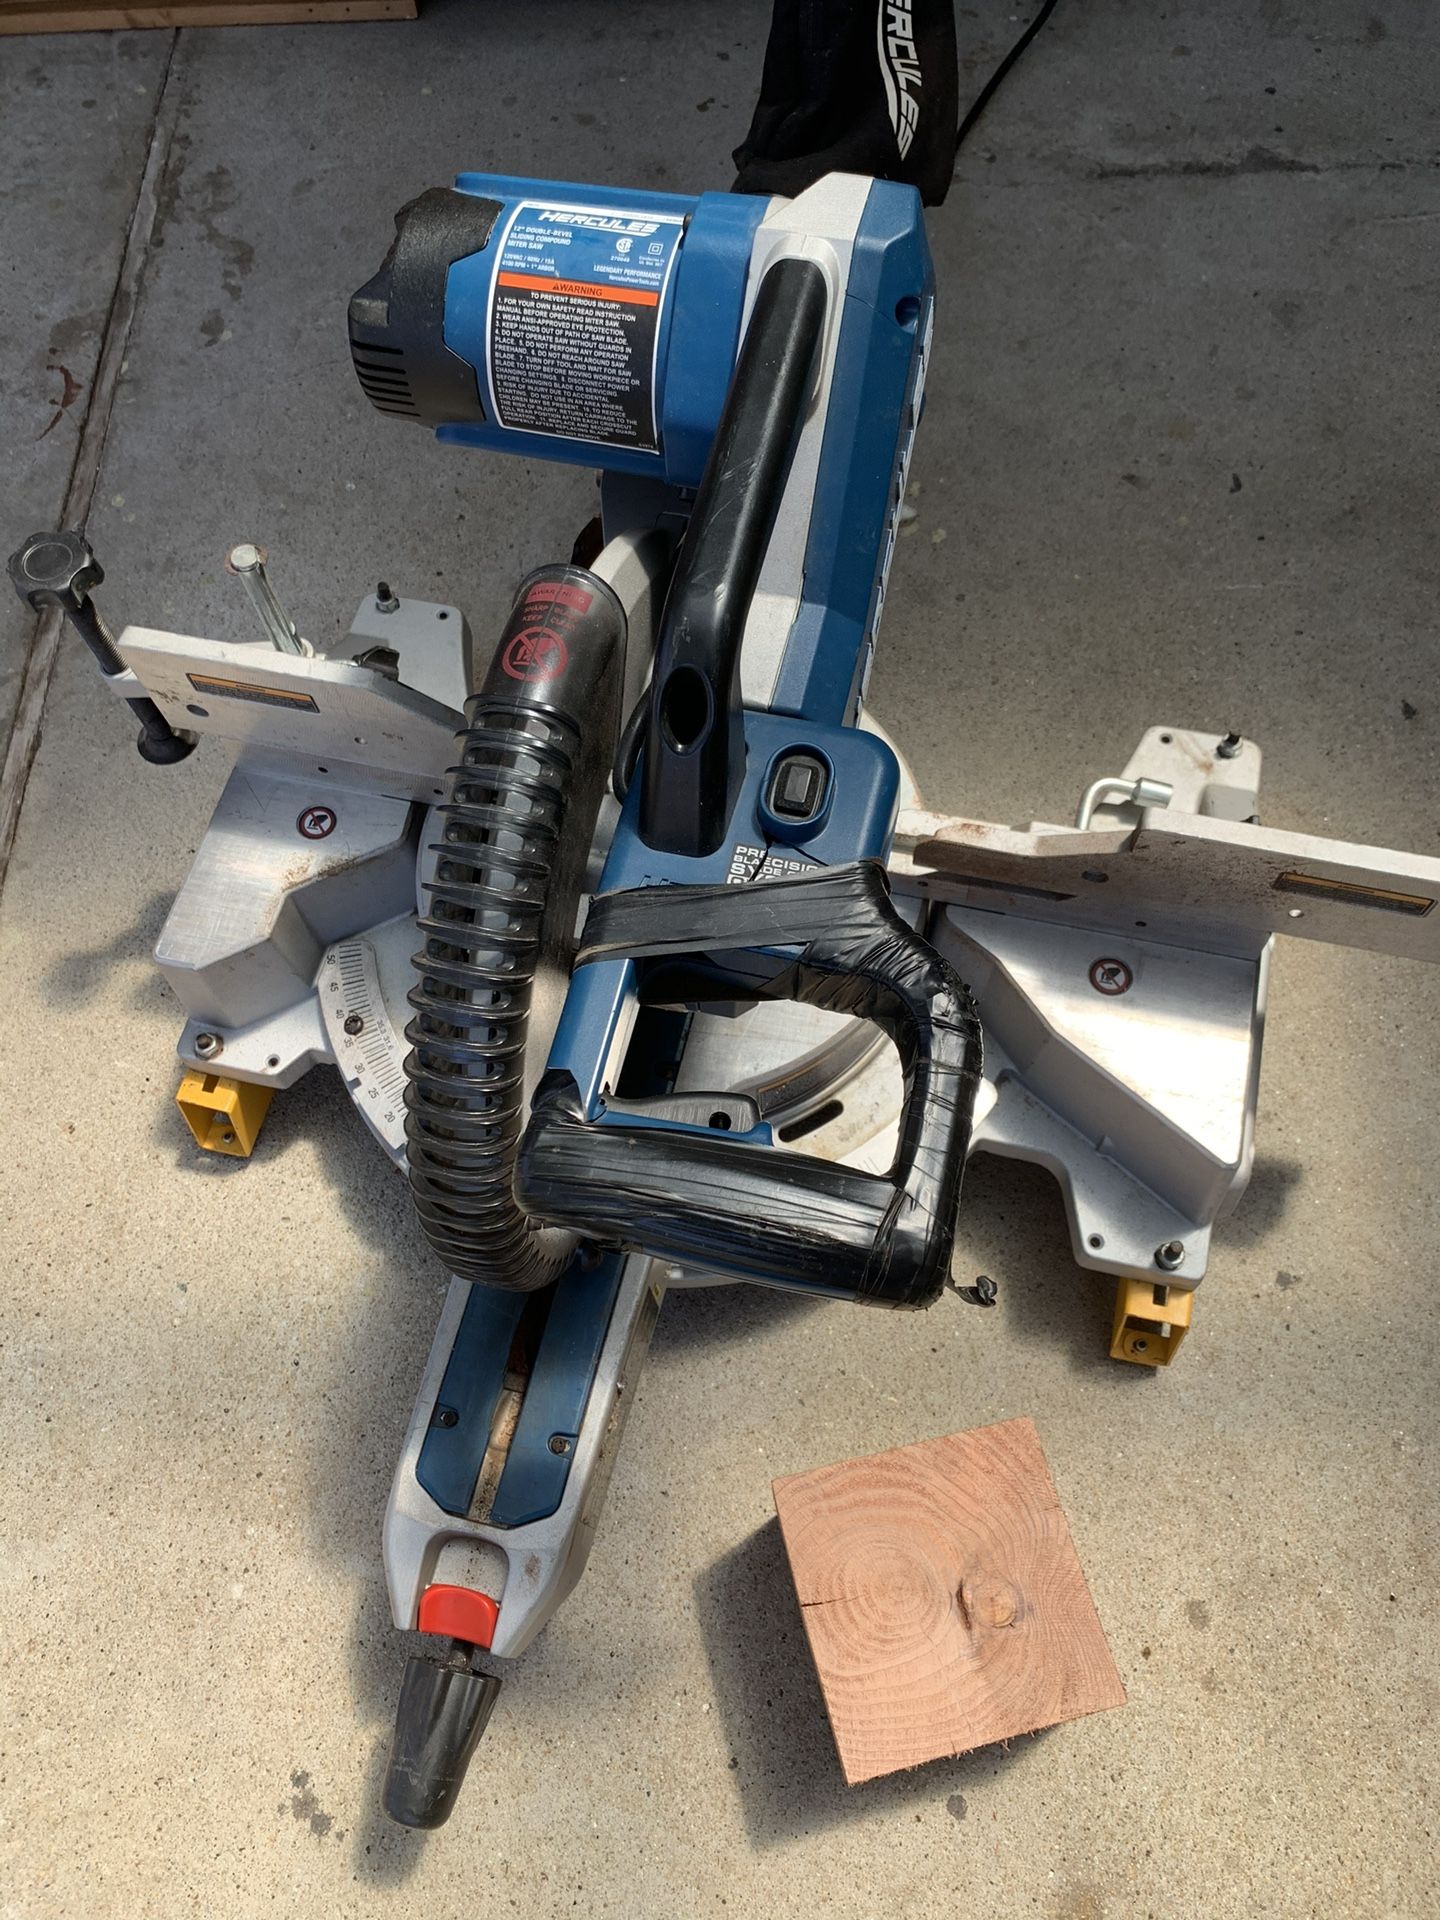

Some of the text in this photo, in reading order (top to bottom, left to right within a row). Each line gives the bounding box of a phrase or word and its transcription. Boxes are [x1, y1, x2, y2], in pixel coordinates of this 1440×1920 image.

[887, 0, 922, 161] RCULES
[538, 211, 661, 233] HERCULES
[560, 284, 602, 296] WARNING
[540, 293, 568, 302] PREVENT
[569, 297, 596, 307] SERIOUS
[597, 301, 621, 310] INJURY:
[496, 305, 522, 314] MANUAL
[523, 308, 548, 317] BEFORE
[549, 312, 584, 322] OPERATING
[585, 317, 604, 325] MITER
[518, 300, 535, 308] YOUR
[536, 302, 551, 310] OWN
[552, 304, 575, 313] SAFETY
[576, 308, 594, 316] READ
[595, 310, 636, 321] INSTRUCTION
[502, 313, 520, 321] WEAR
[521, 316, 570, 328] ANSI-APPROVED
[571, 323, 583, 331] EYE
[502, 321, 518, 329] KEEP
[519, 324, 540, 332] HANDS
[564, 330, 580, 338] PATH
[525, 333, 553, 342] OPERATE
[569, 339, 597, 348] WITHOUT
[598, 343, 624, 352] GUARDS
[547, 351, 560, 359] NOT
[561, 353, 583, 362] REACH
[584, 357, 610, 366] AROUND
[611, 360, 625, 368] SAW
[549, 344, 579, 353] PERFORM
[593, 350, 628, 360] OPERATION
[495, 359, 515, 367] BLADE
[542, 366, 566, 375] BEFORE
[568, 370, 592, 379] MOVING
[593, 374, 629, 384] WORKPIECE
[526, 356, 542, 364] TURN
[556, 360, 572, 369] TOOL
[603, 367, 616, 375] FOR
[618, 369, 632, 377] SAW
[495, 367, 527, 376] CHANGING
[567, 377, 606, 388] DISCONNECT
[607, 383, 630, 391] POWER
[496, 374, 520, 382] BEFORE
[521, 378, 552, 387] CHANGING
[553, 382, 573, 390] BLADE
[585, 387, 617, 397] SERVICING
[527, 385, 548, 393] INJURY
[572, 392, 609, 402] ACCIDENTAL
[736, 846, 819, 871] PRECISI
[327, 954, 336, 965] 50
[330, 982, 339, 993] 45
[335, 1009, 345, 1020] 40
[343, 1036, 354, 1048] 35
[354, 1063, 366, 1075] 30
[367, 1087, 380, 1099] 25
[384, 1111, 396, 1123] 20
